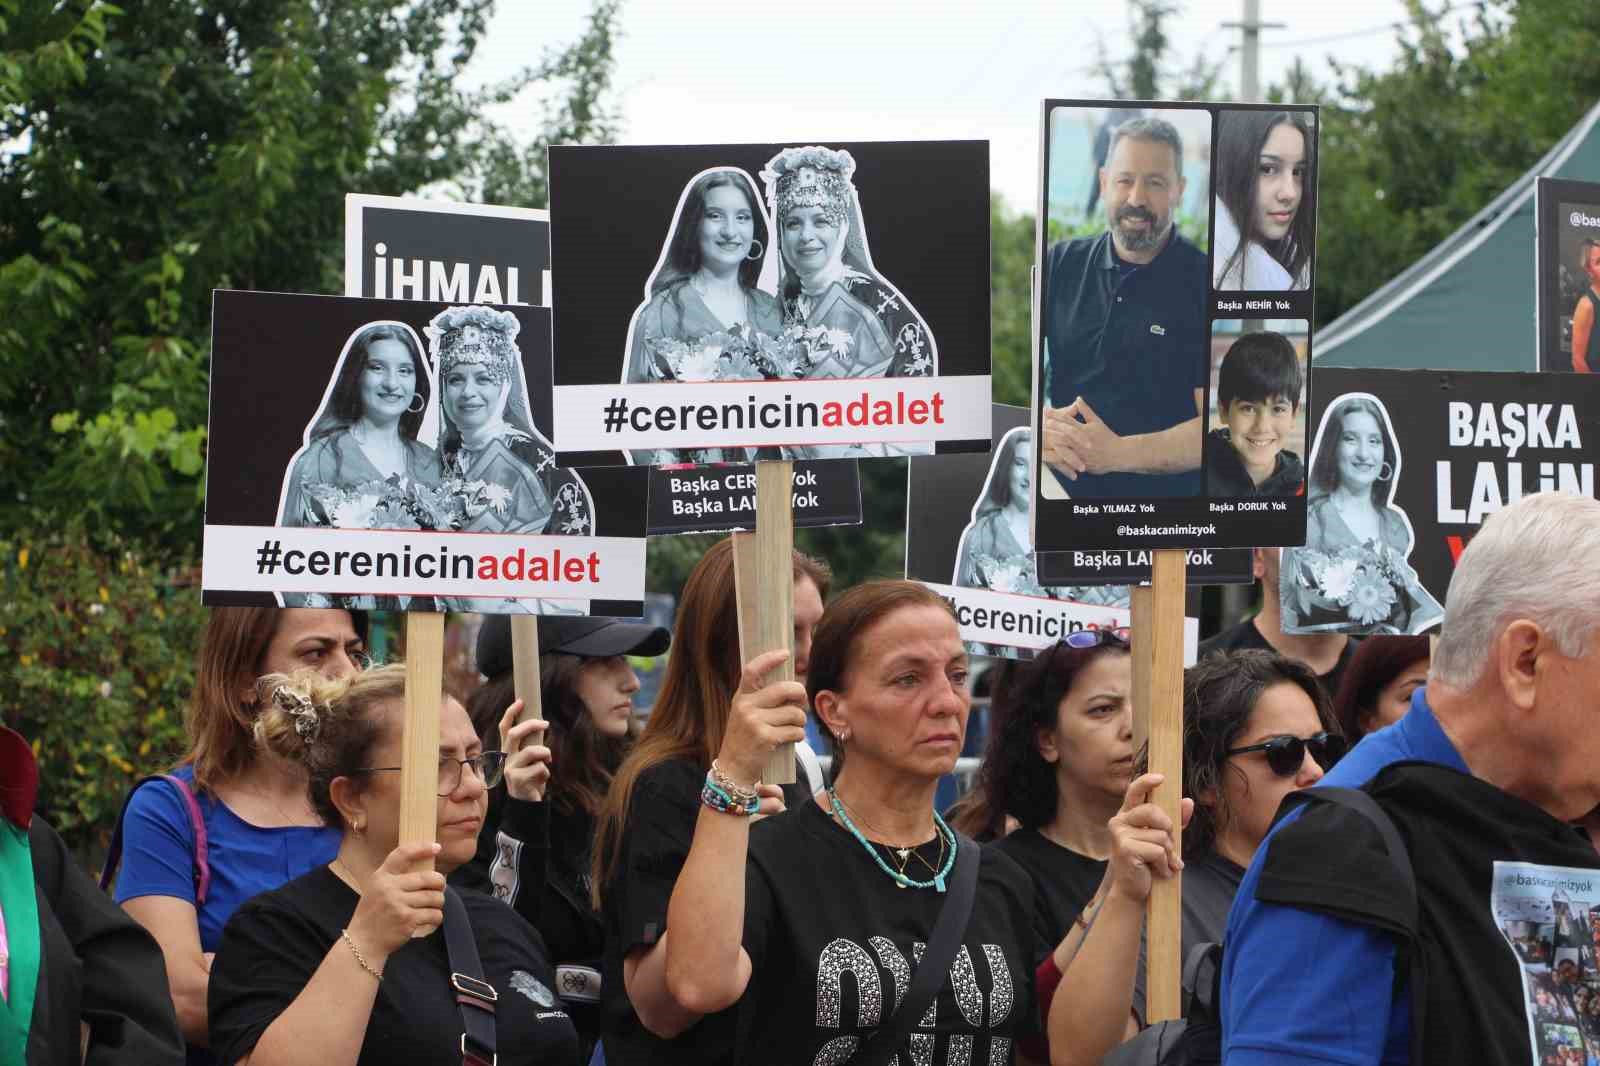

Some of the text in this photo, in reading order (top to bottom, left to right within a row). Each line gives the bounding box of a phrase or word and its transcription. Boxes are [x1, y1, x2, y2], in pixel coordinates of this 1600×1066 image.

[375, 242, 528, 306] İHMAL
[1217, 299, 1290, 311] Başka NEHİR Yok
[604, 392, 944, 433] #cerenicinadalet
[1449, 401, 1582, 458] BAŞKA
[670, 476, 720, 493] Başka
[725, 474, 757, 490] CER
[672, 498, 723, 518] Başka
[1073, 503, 1156, 516] Başka YILMAZ Yok
[1209, 501, 1287, 512] Başka DORUK Yok
[1117, 523, 1216, 537] @baskacanimizyok
[256, 540, 600, 583] #cerenicinadalet
[1074, 551, 1121, 570] Başka
